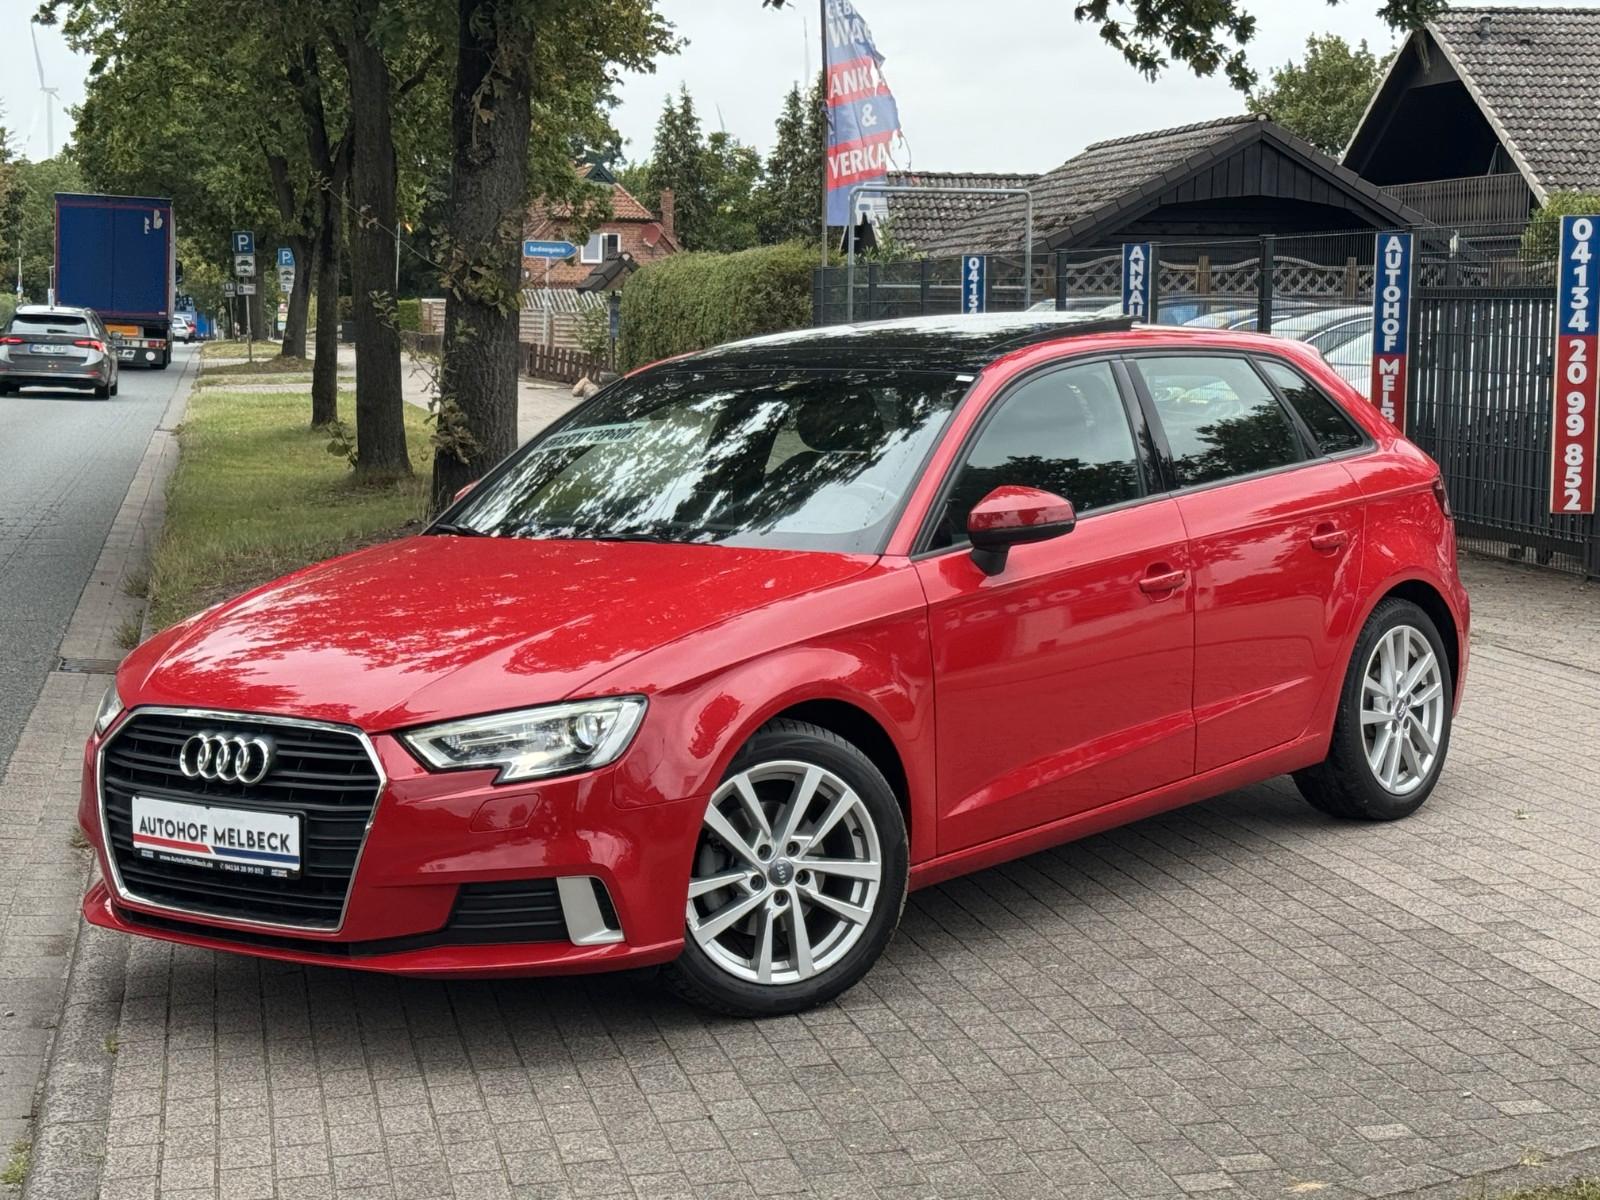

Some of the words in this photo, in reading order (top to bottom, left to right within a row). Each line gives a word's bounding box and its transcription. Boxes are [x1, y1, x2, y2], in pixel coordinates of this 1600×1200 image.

[861, 103, 877, 127] &
[237, 234, 249, 252] P
[282, 251, 292, 264] P
[1128, 245, 1145, 325] ANKAU
[1382, 236, 1403, 352] AUTOHOF
[1568, 218, 1593, 332] 04134
[1567, 339, 1587, 385] 20
[1566, 391, 1586, 437] 99
[1563, 443, 1584, 511] 852
[139, 816, 208, 843] AUTOHOF
[213, 826, 291, 853] MELBECK
